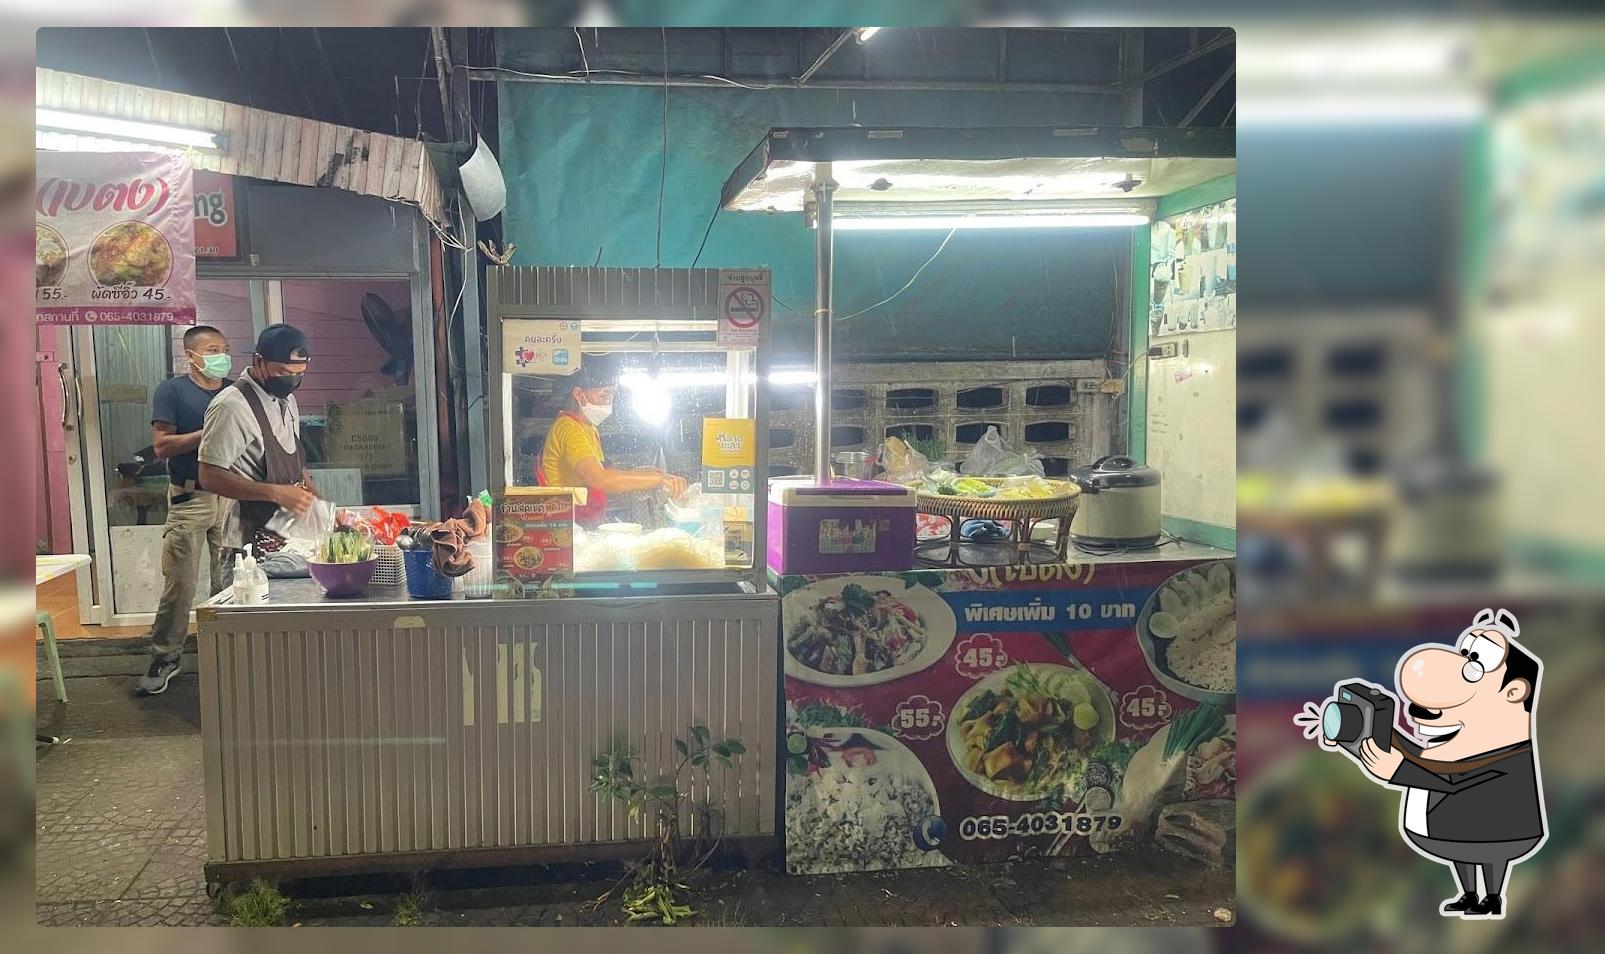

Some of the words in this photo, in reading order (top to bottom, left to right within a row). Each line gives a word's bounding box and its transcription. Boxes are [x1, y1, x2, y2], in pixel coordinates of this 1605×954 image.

[36, 177, 170, 217] (เบตง)
[100, 311, 174, 322] 065-4031879
[964, 597, 1056, 622] พิเศษเพิ่ม
[1066, 603, 1092, 620] 10
[1100, 603, 1136, 618] บาท
[961, 813, 1123, 838] 065-4031879
